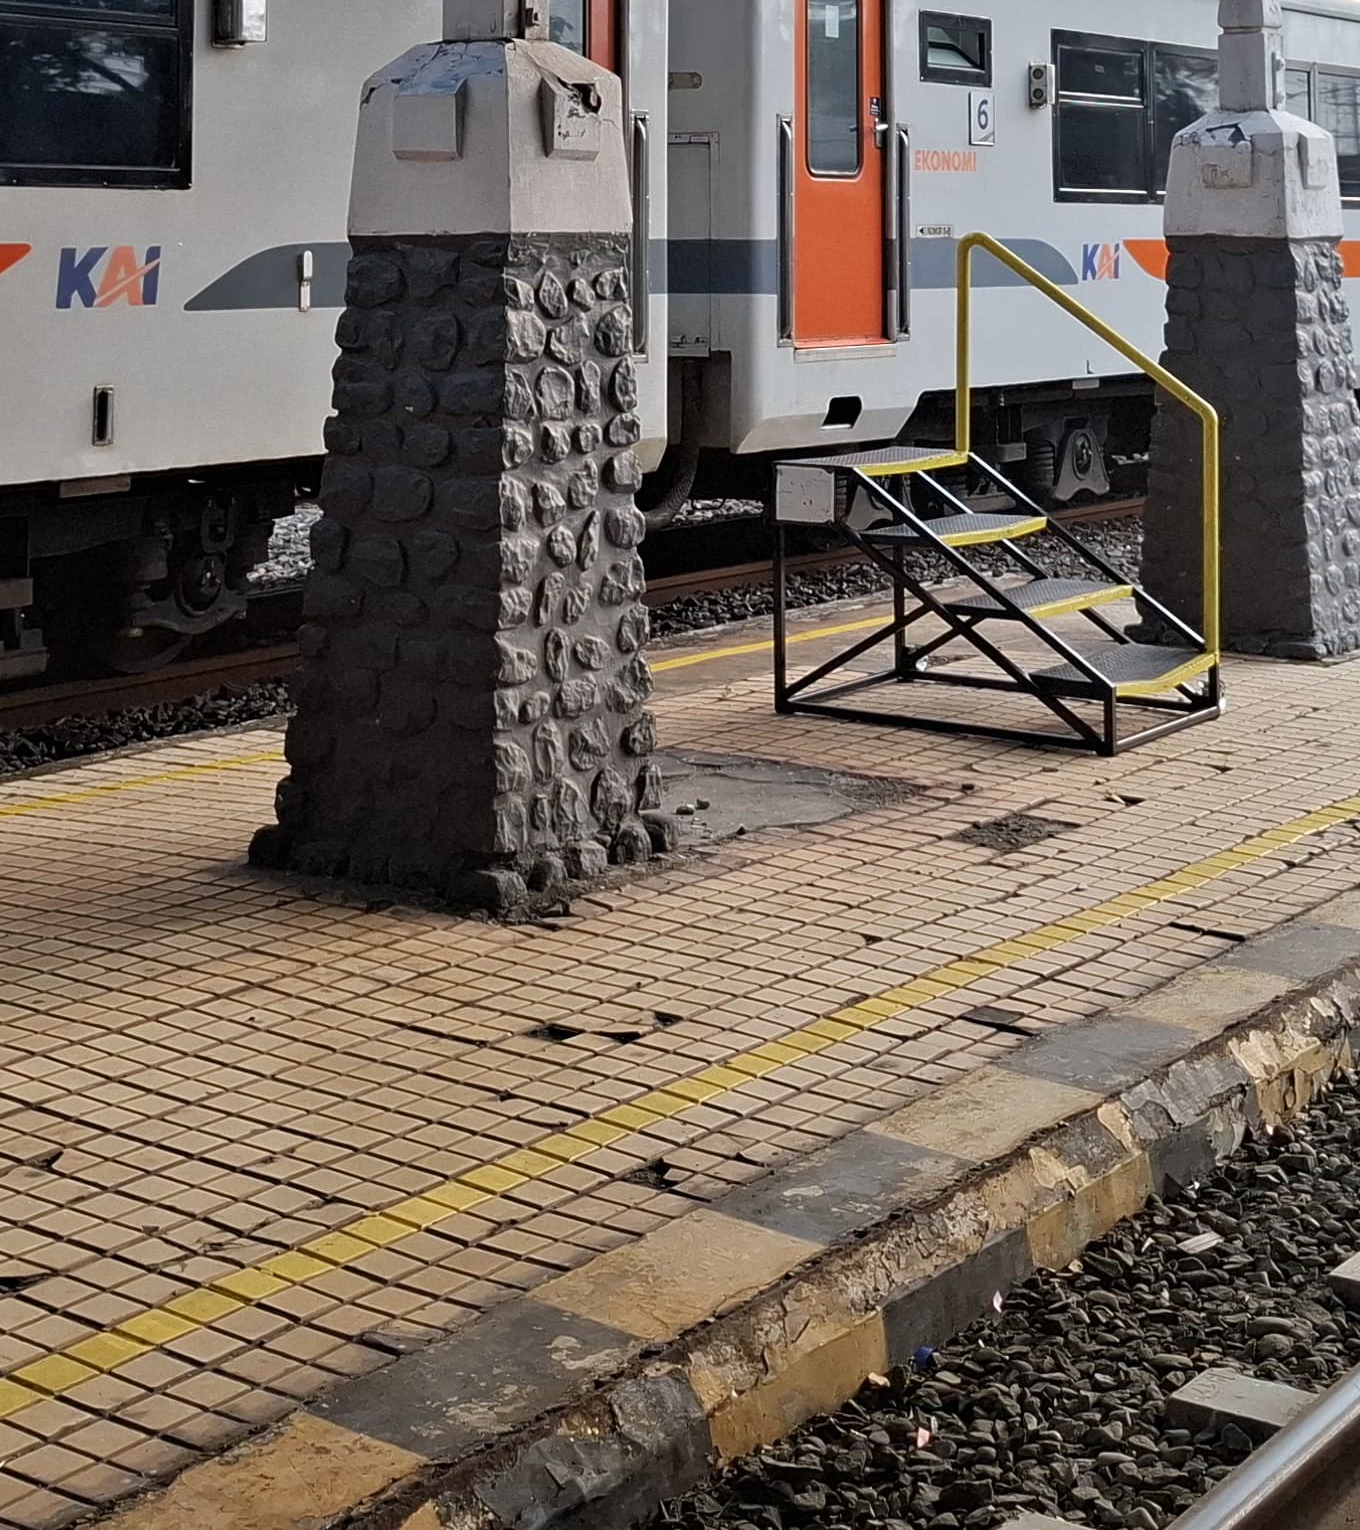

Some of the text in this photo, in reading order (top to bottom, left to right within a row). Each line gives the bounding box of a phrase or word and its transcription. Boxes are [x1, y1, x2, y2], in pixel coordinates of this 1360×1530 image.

[977, 99, 989, 130] 6
[914, 149, 977, 172] EKONOMI
[55, 245, 162, 309] KAI
[1082, 243, 1120, 281] KAI
